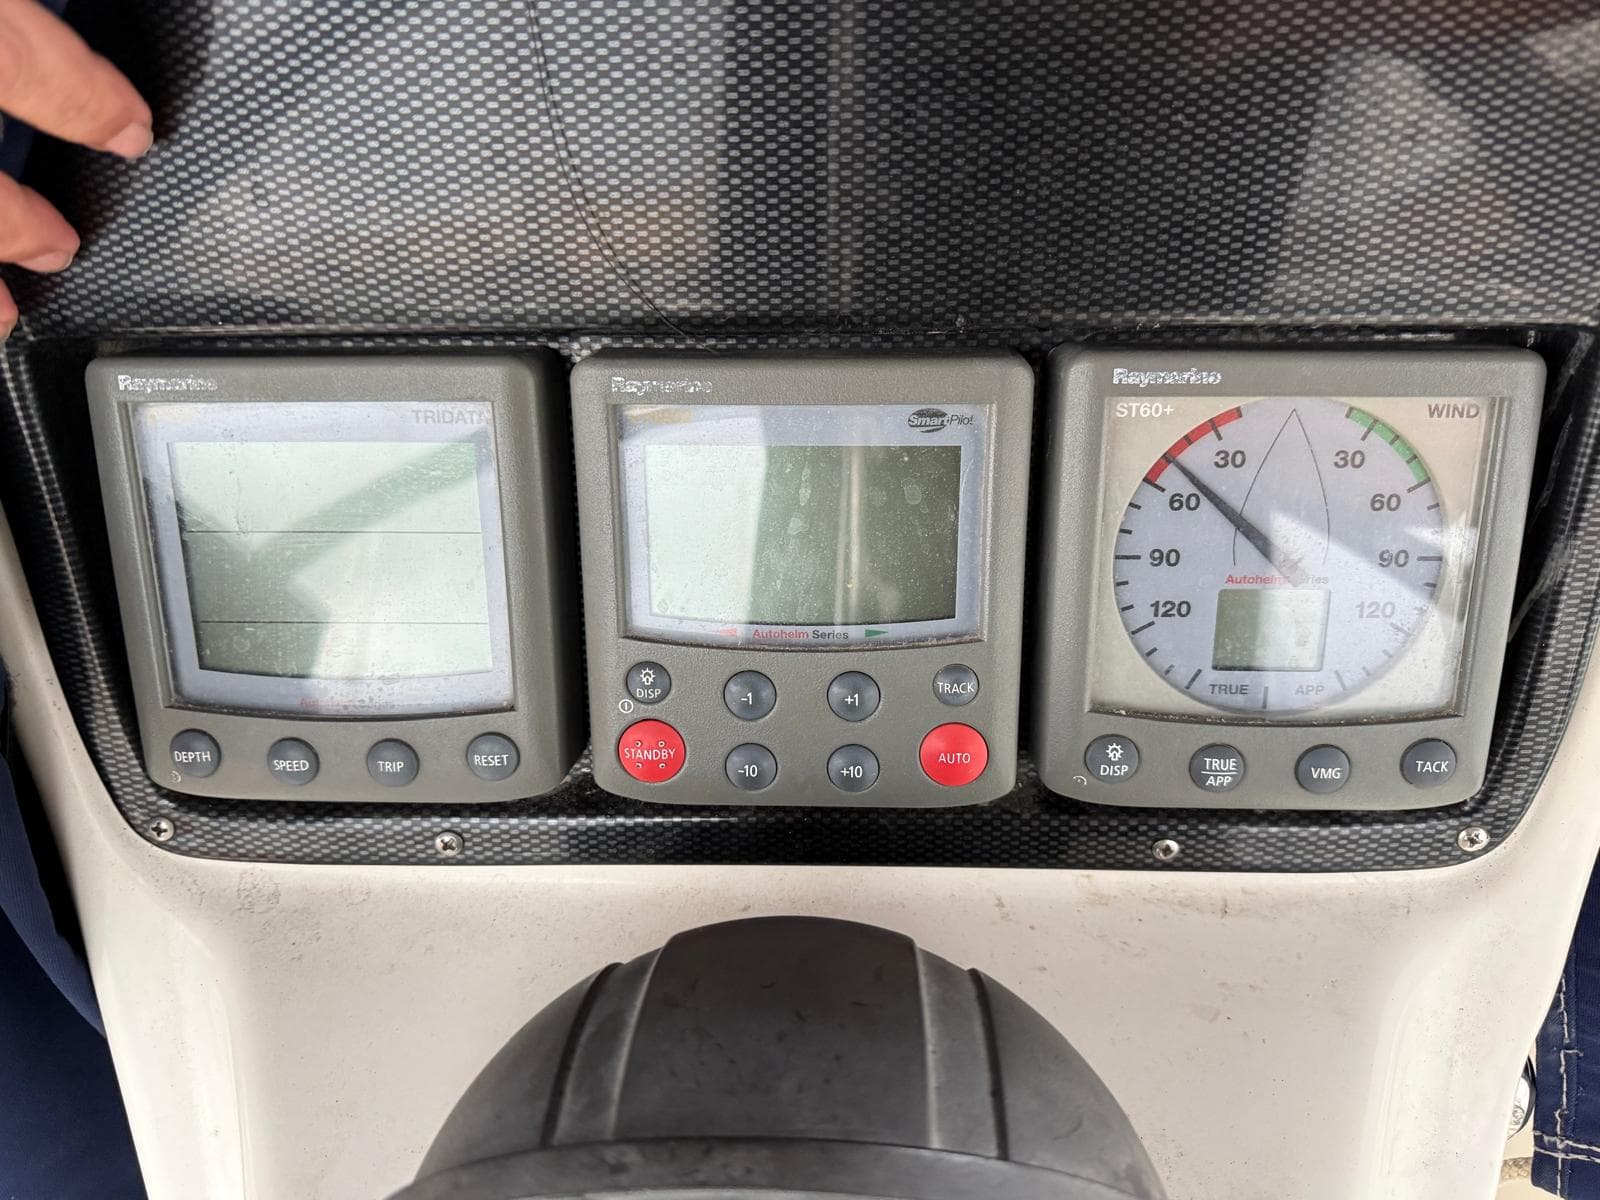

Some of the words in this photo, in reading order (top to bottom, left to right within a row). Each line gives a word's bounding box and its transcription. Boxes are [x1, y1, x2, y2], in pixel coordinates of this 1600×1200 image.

[1115, 403, 1174, 418] ST60+
[1427, 403, 1480, 419] WIND
[1213, 449, 1247, 468] 30
[1333, 449, 1366, 469] 30
[1168, 493, 1201, 512] 60
[1370, 493, 1401, 512] 60
[1149, 548, 1181, 567] 90
[1378, 549, 1409, 568] 90
[1149, 600, 1192, 618] 120
[1355, 601, 1396, 619] 120
[752, 629, 809, 640] Autohelm
[812, 630, 849, 640] Series
[636, 688, 661, 699] DISP
[937, 682, 975, 694] TRACK
[1209, 683, 1250, 695] TRUE
[1295, 684, 1325, 696] APP
[740, 693, 753, 705] -1
[844, 693, 860, 706] +1
[174, 750, 211, 763] DEPTH
[474, 754, 508, 767] RESET
[624, 748, 676, 761] STANDBY
[938, 752, 971, 764] AUTO
[273, 759, 309, 772] SPEED
[377, 760, 404, 773] TRIP
[1100, 764, 1129, 776] DISP
[1204, 757, 1238, 771] TRUE
[1416, 760, 1449, 773] TACK
[737, 764, 758, 778] -10
[840, 765, 863, 779] +10
[1310, 767, 1342, 779] VMG
[1206, 774, 1232, 787] APP
